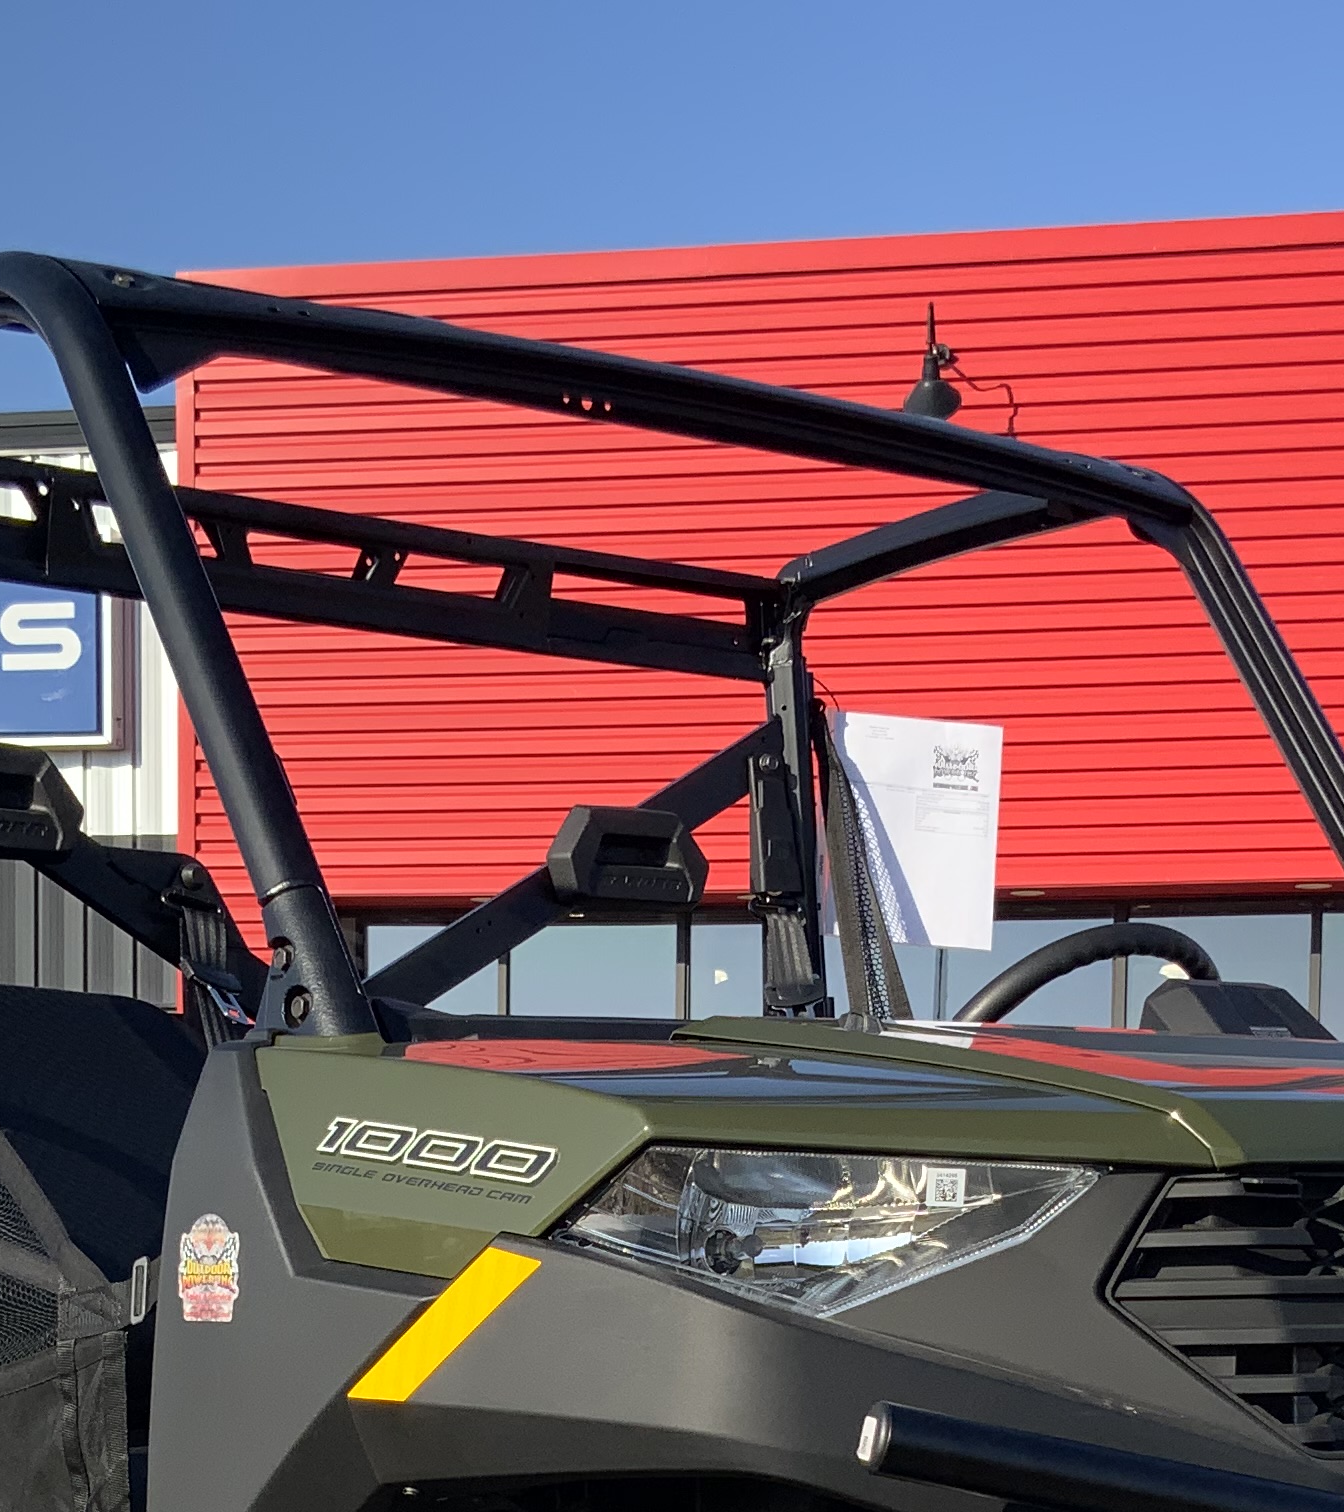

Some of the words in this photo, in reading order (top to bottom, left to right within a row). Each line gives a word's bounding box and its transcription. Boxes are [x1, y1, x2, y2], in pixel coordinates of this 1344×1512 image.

[316, 1116, 560, 1187] 1000
[312, 1161, 378, 1179] SINGLE
[381, 1173, 484, 1197] OVERHEAD
[486, 1189, 534, 1205] CAM
